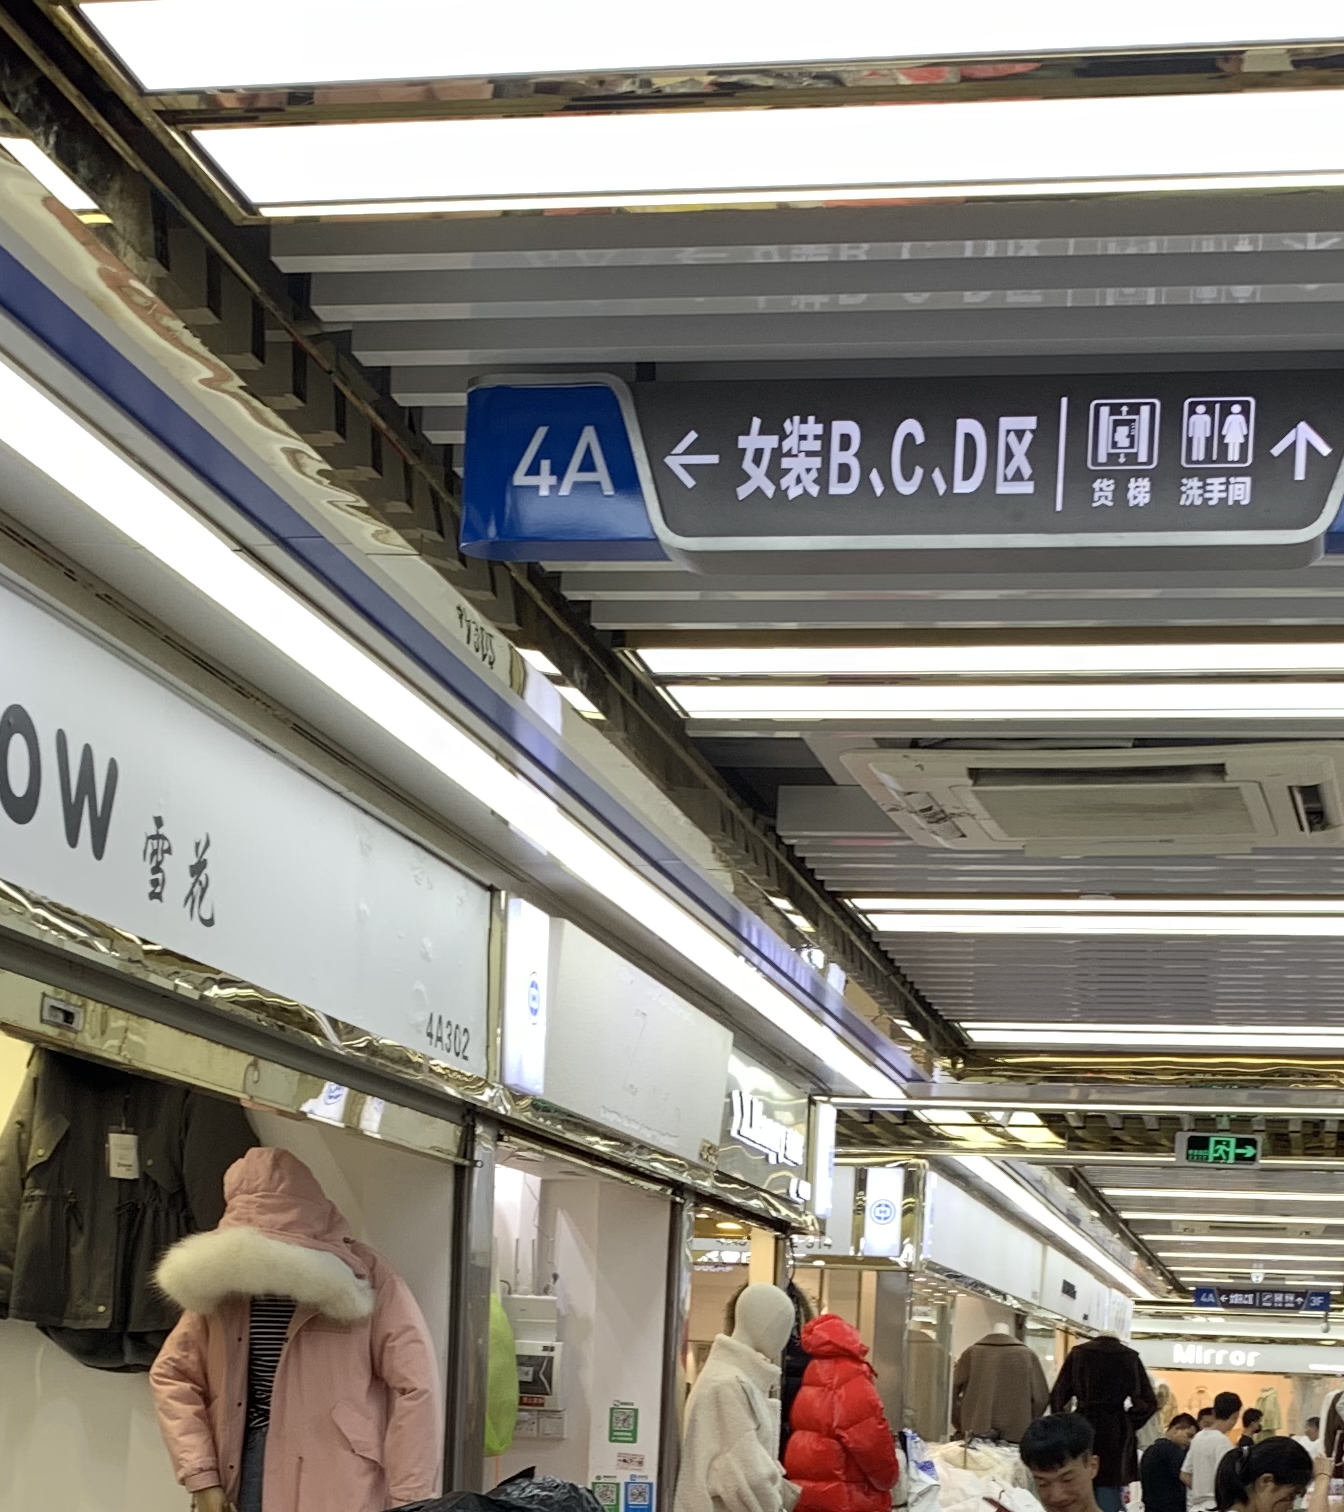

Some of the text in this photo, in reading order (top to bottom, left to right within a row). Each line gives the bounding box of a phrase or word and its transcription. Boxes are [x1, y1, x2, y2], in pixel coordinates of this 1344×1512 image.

[512, 424, 615, 497] 4A
[735, 415, 1038, 501] 女装B、C、D区
[1179, 476, 1252, 507] 洗手间
[141, 815, 216, 928] 雪花
[424, 1011, 471, 1063] 4A302
[1173, 1343, 1261, 1367] Mirror
